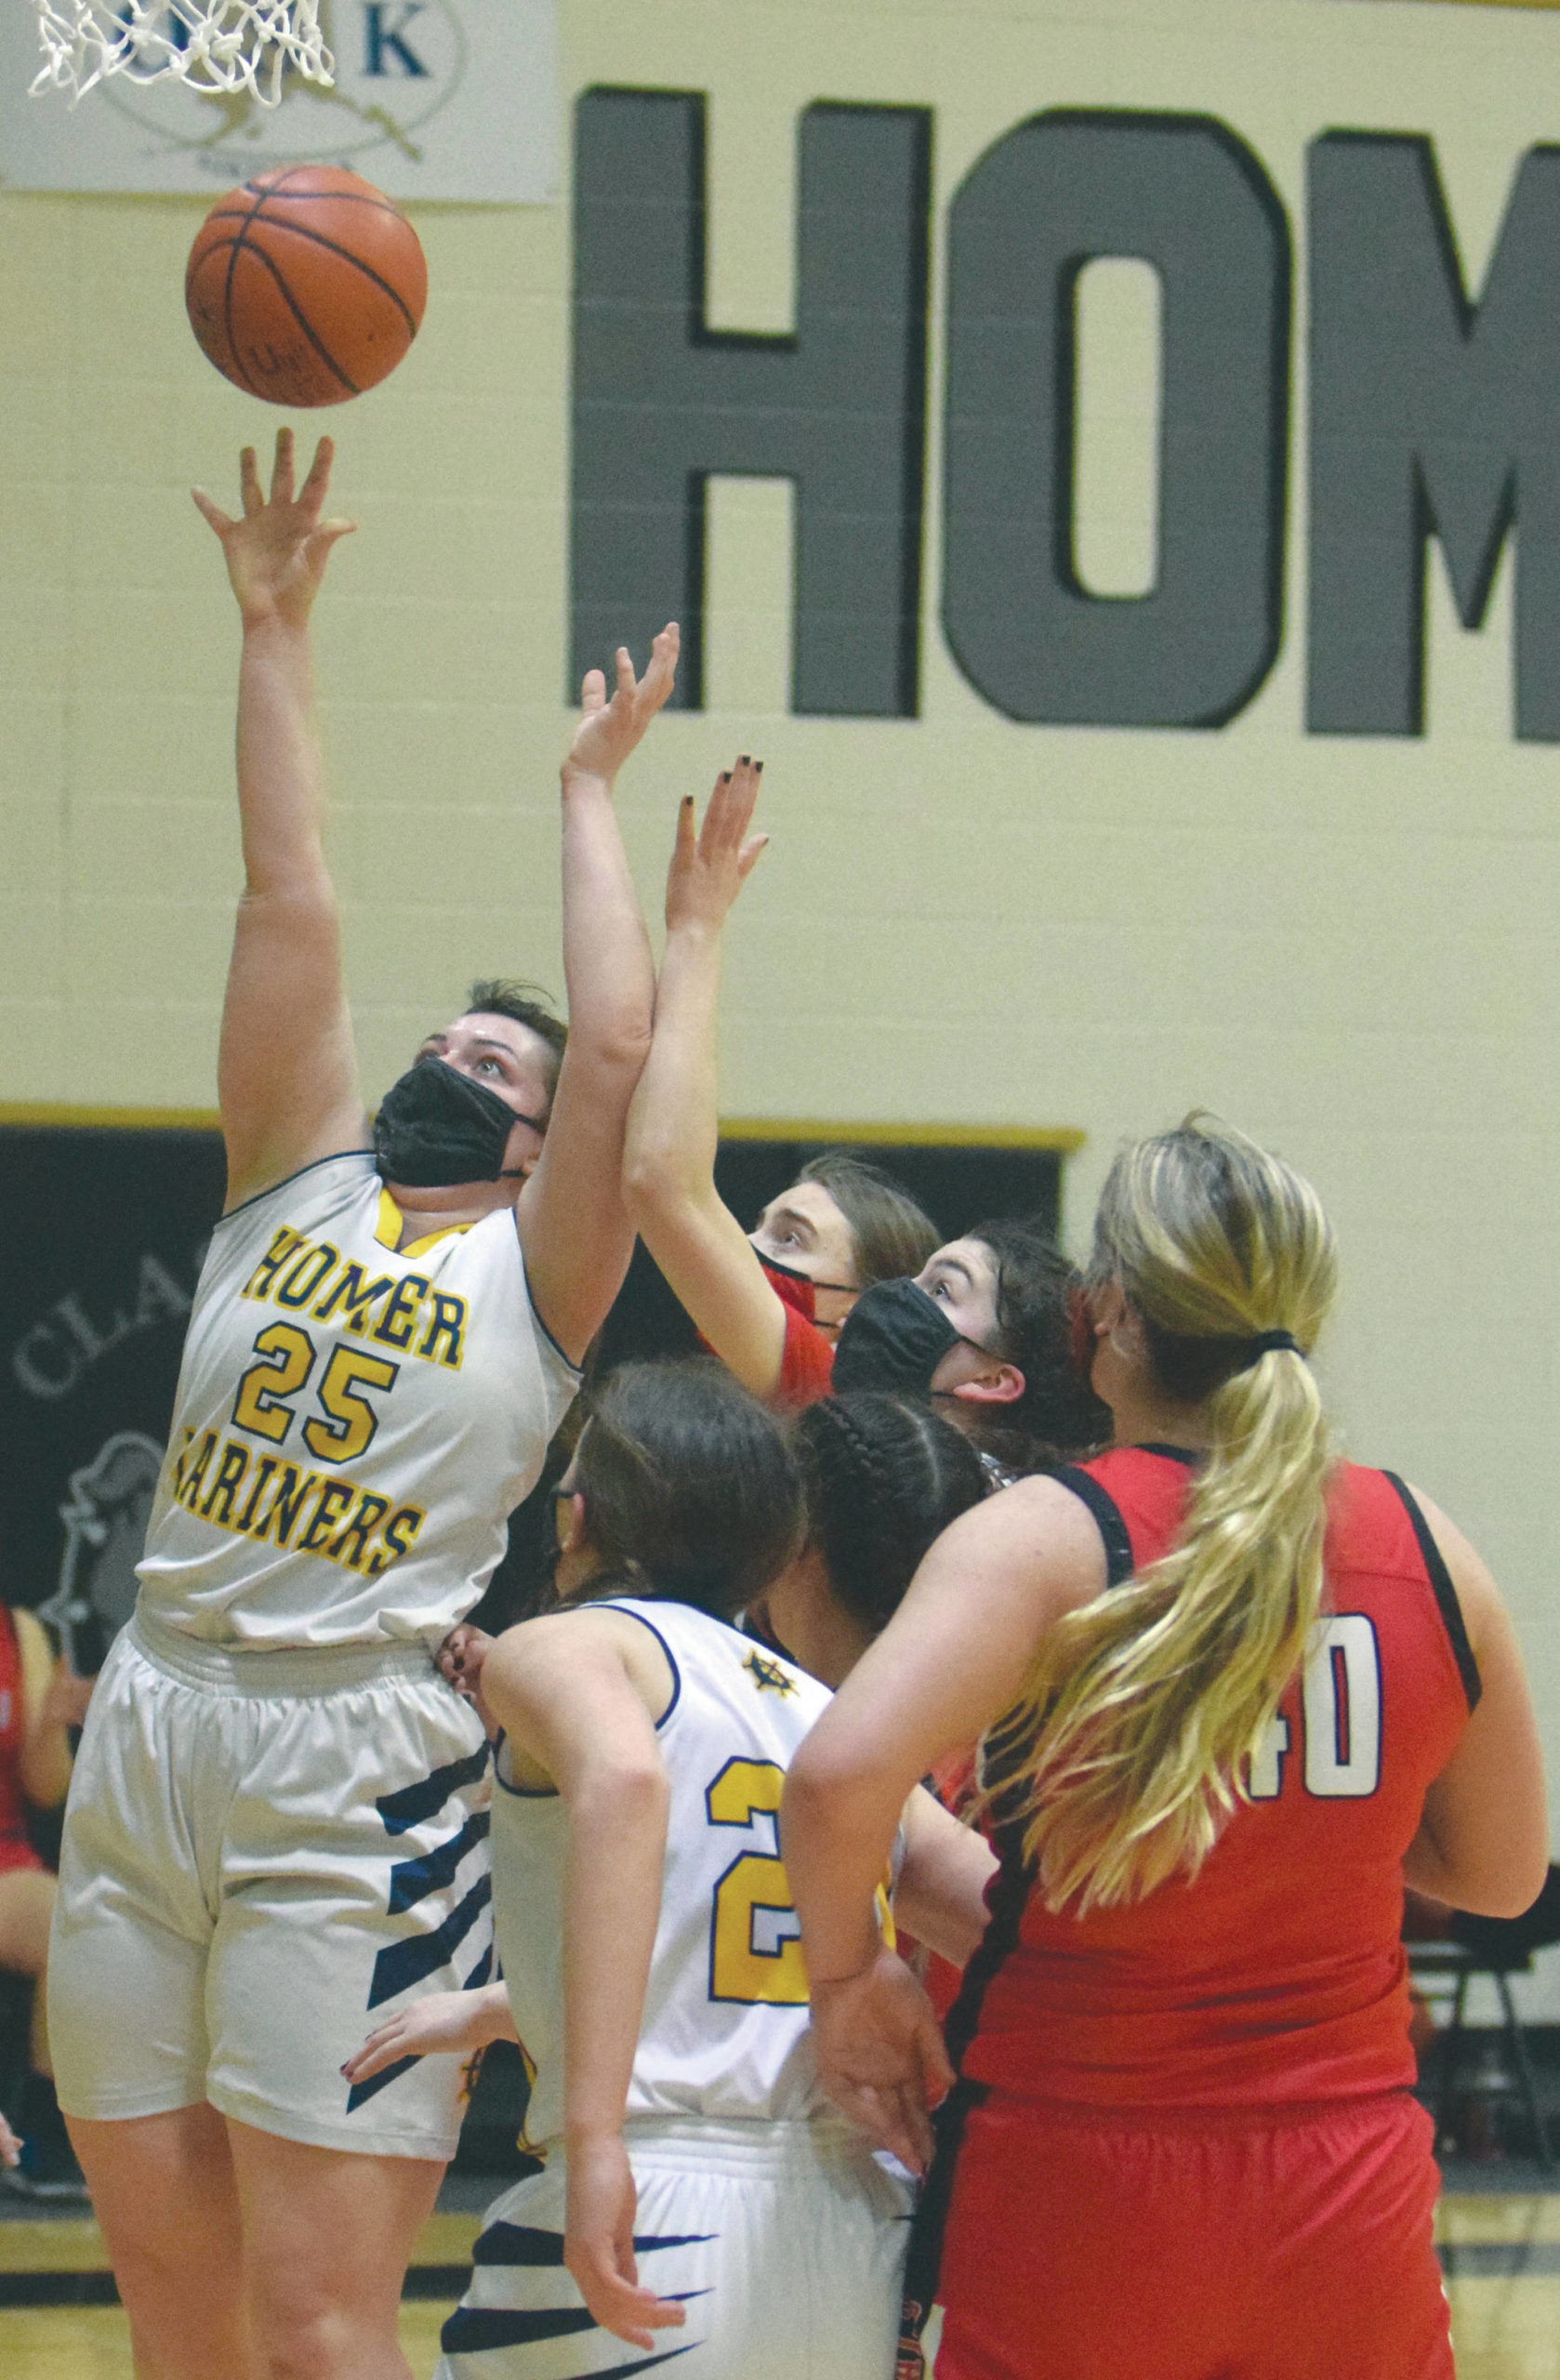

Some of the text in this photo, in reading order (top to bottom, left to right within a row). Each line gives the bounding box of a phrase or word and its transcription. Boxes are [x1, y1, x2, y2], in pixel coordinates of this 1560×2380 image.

[566, 82, 1560, 744] HOM
[13, 1242, 210, 1399] CLA
[240, 1224, 469, 1371] HOMER
[231, 1320, 401, 1465] 25
